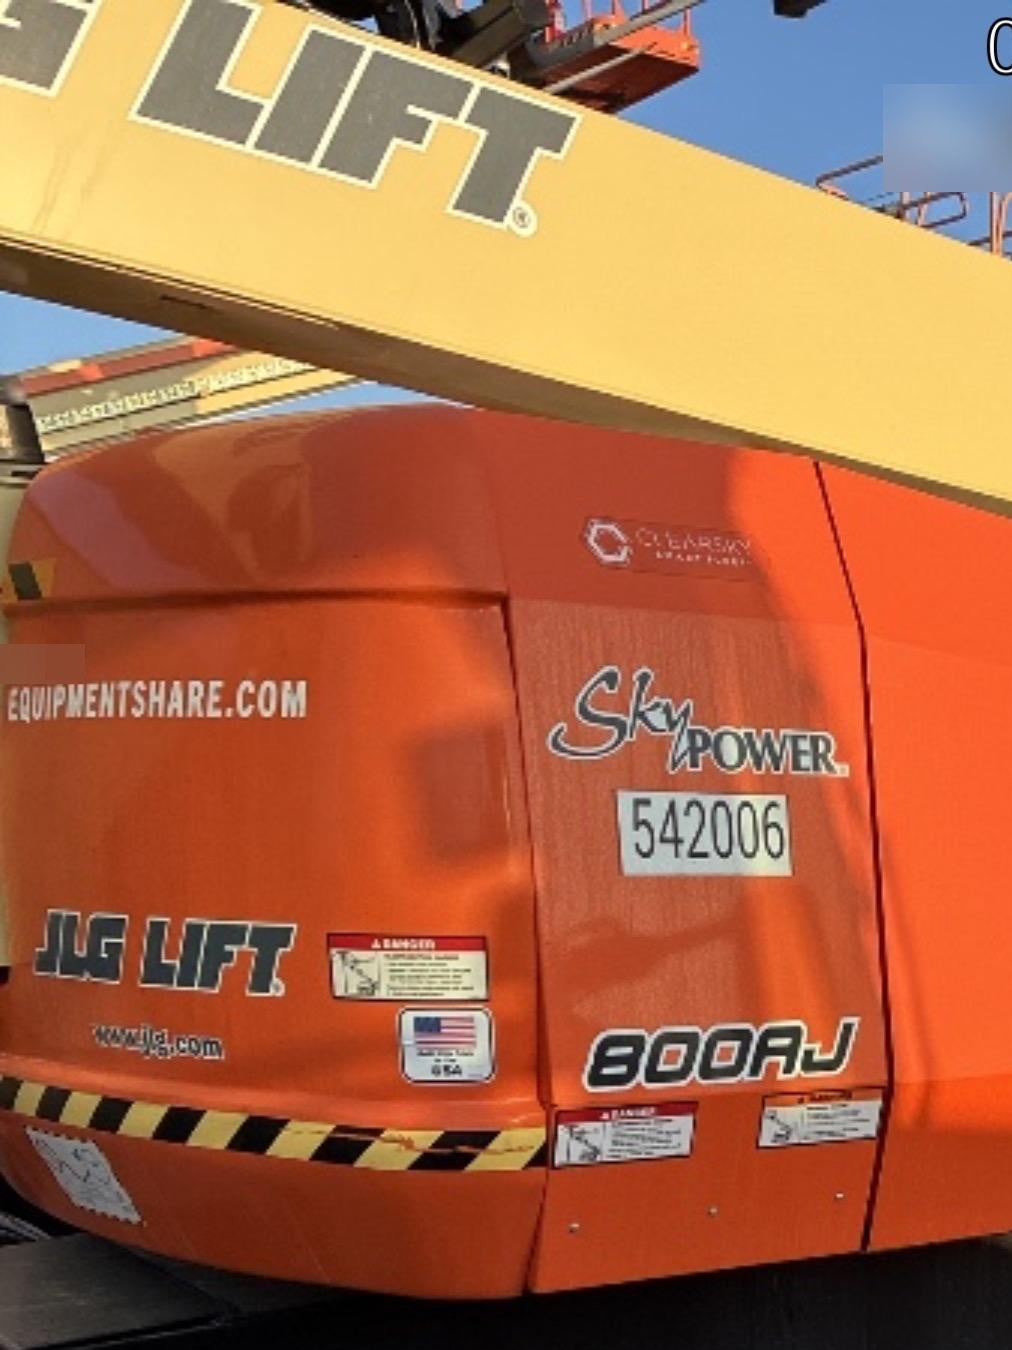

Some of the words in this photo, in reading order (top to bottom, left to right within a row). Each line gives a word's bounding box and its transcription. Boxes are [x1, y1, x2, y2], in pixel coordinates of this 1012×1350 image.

[129, 0, 583, 230] LIFT
[7, 679, 308, 724] EQUIPMENTSHARE.COM
[631, 797, 785, 859] 542006
[33, 908, 129, 984] JLG
[137, 917, 298, 997] LIFT
[581, 1016, 861, 1092] 800AJ
